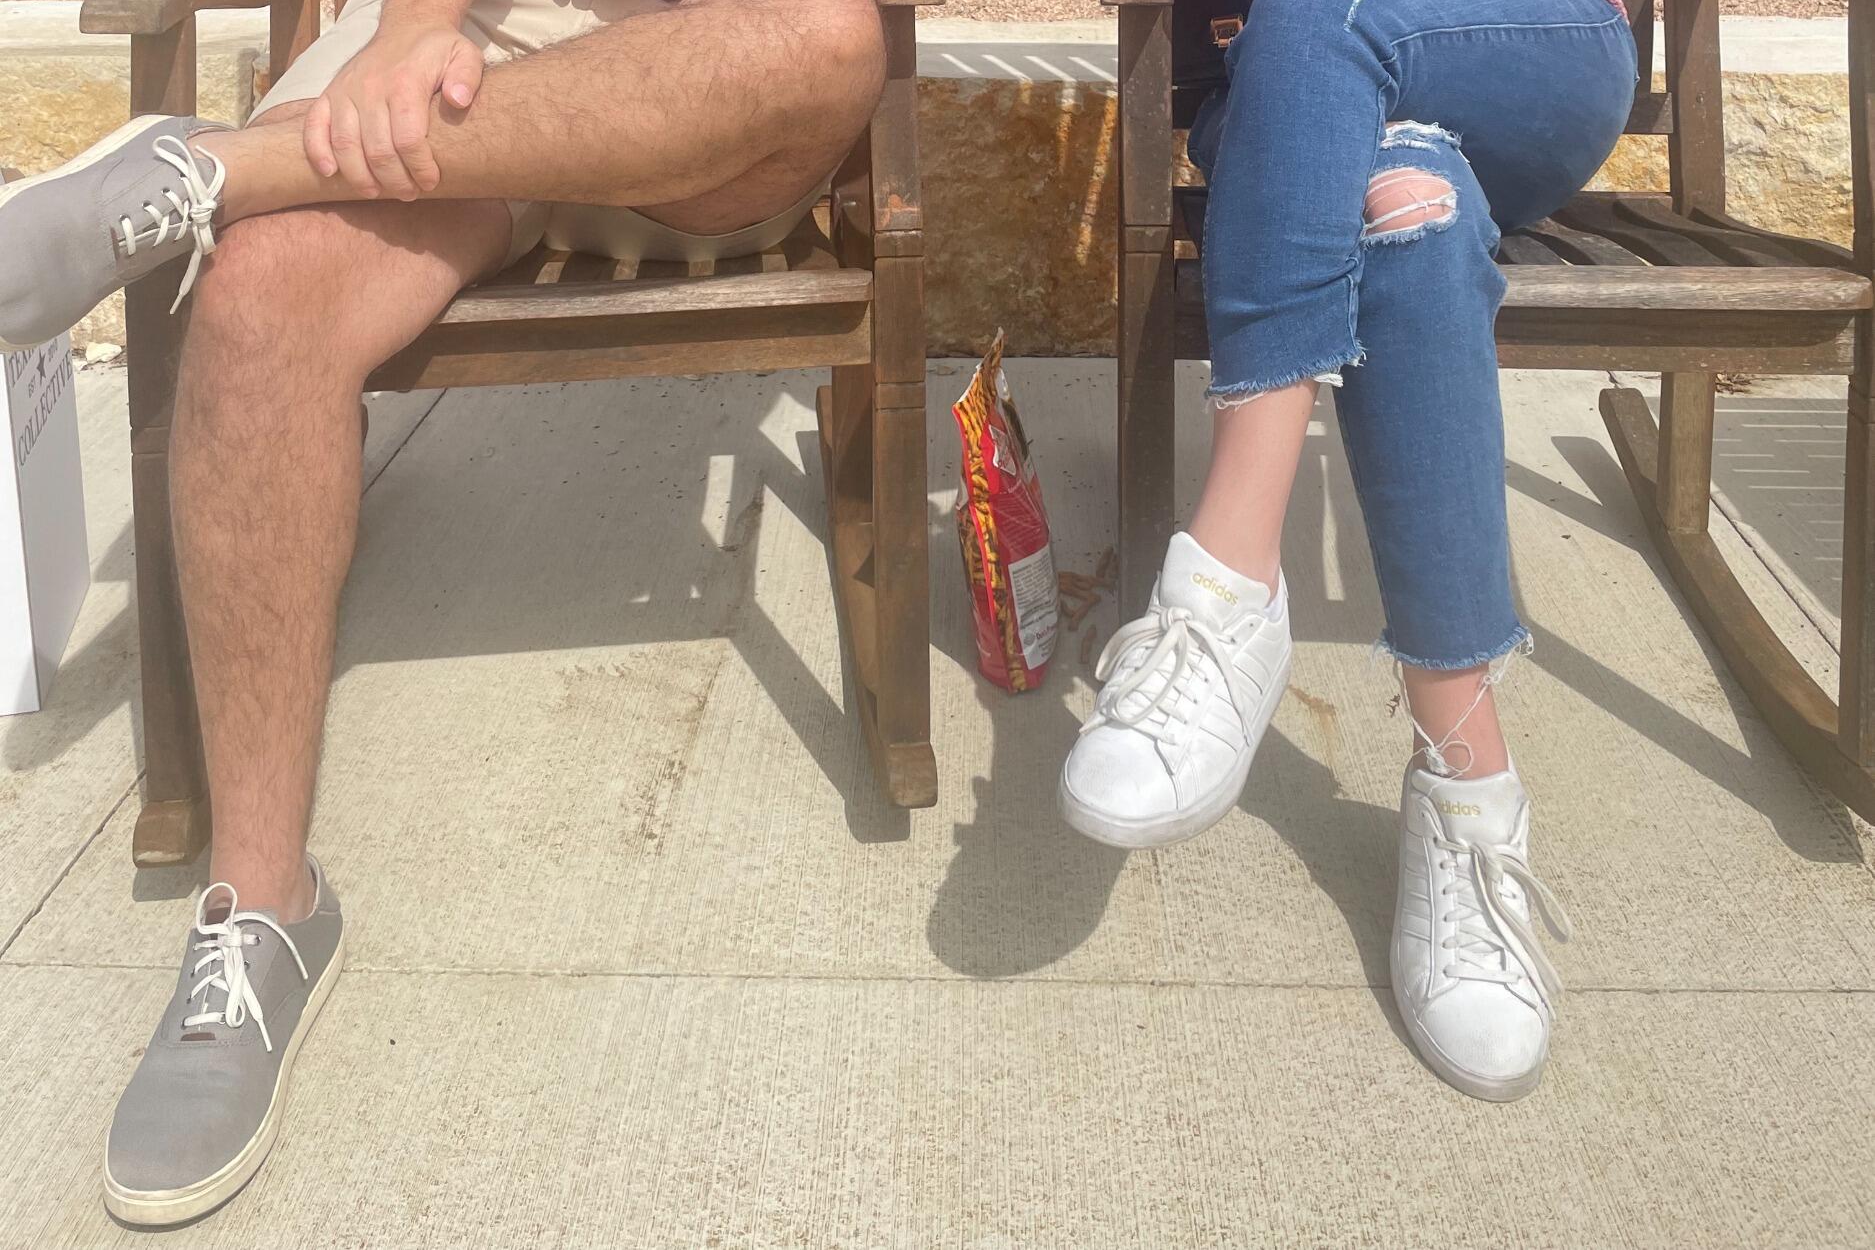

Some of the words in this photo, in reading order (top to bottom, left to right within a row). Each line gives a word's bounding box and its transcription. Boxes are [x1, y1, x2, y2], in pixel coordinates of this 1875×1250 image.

[18, 350, 73, 466] COLLECTIVE
[1193, 572, 1239, 606] adidas
[1439, 799, 1481, 816] didas
